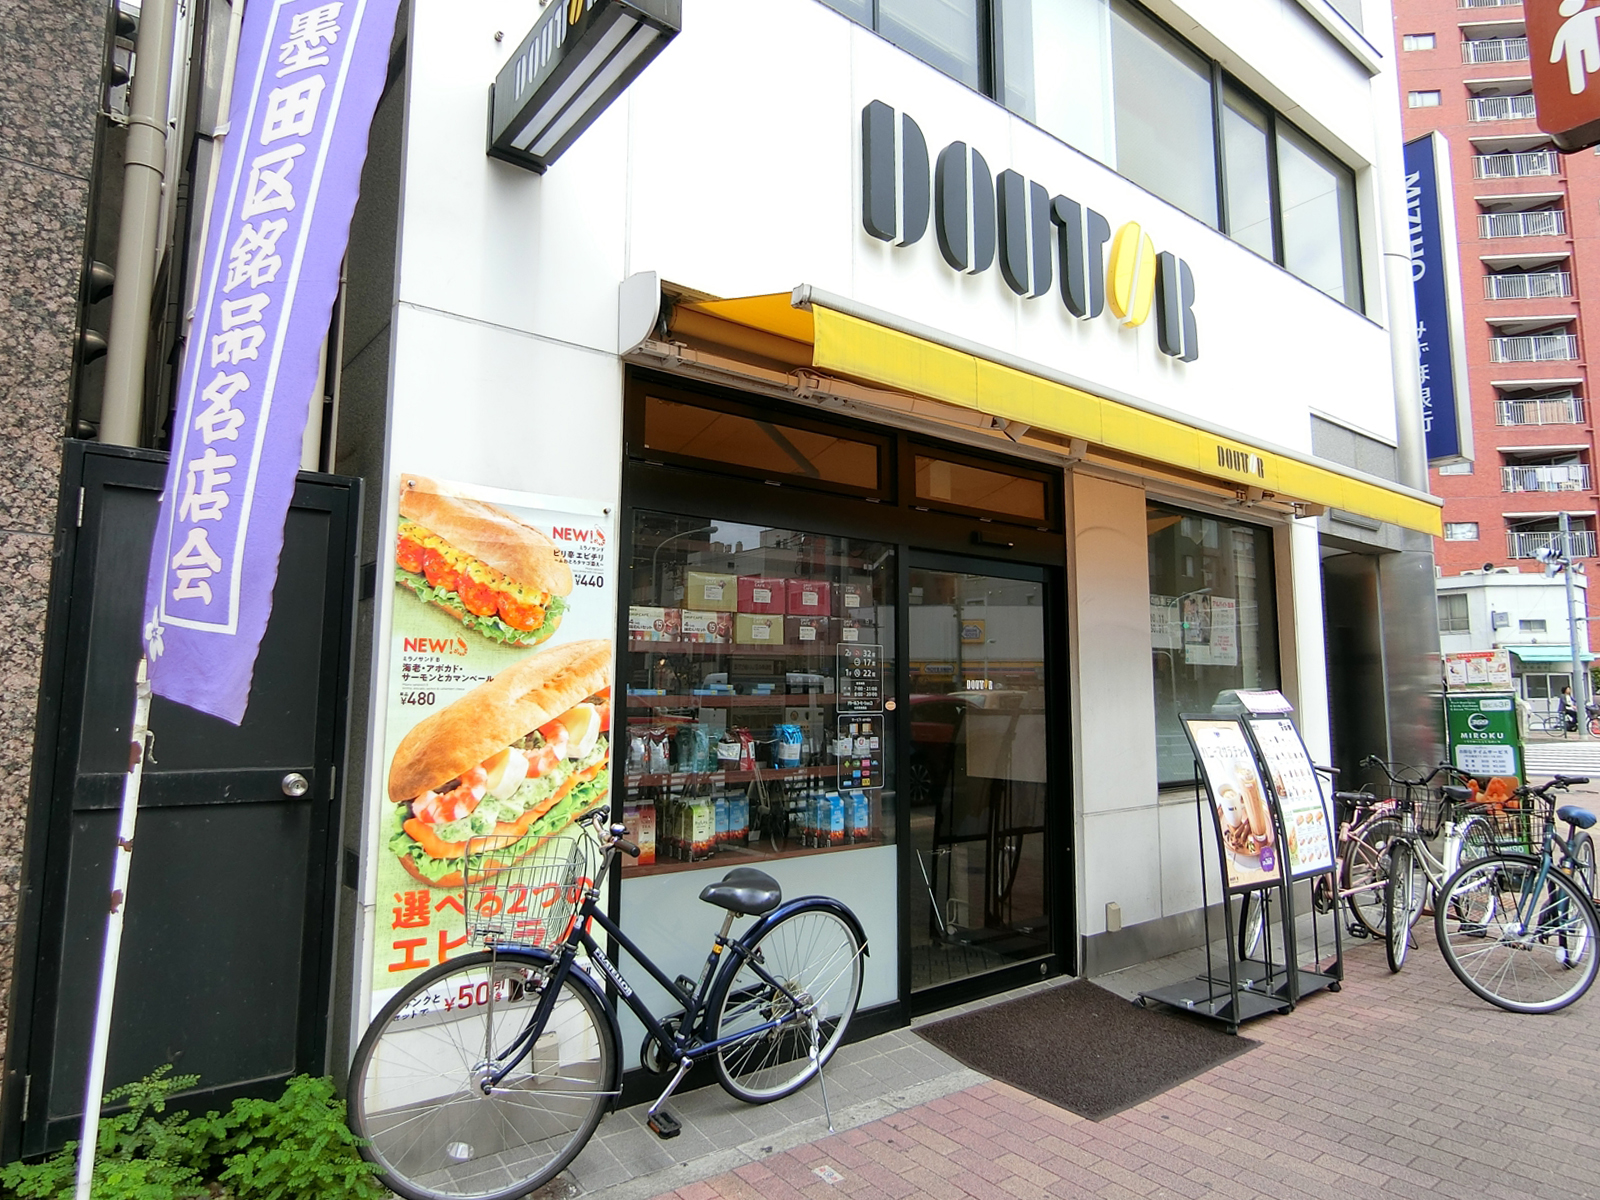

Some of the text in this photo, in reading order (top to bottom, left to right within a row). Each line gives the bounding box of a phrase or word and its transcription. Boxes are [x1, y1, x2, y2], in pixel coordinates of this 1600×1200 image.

[515, 0, 597, 101] DOUTO
[862, 99, 1199, 363] DOUTOR
[172, 1, 344, 606] 墨田区銘品名店会
[1217, 445, 1264, 479] DOUTOR
[553, 526, 593, 544] NEW!
[575, 575, 604, 588] ¥440
[404, 637, 454, 655] NEW!
[401, 691, 435, 706] ¥480
